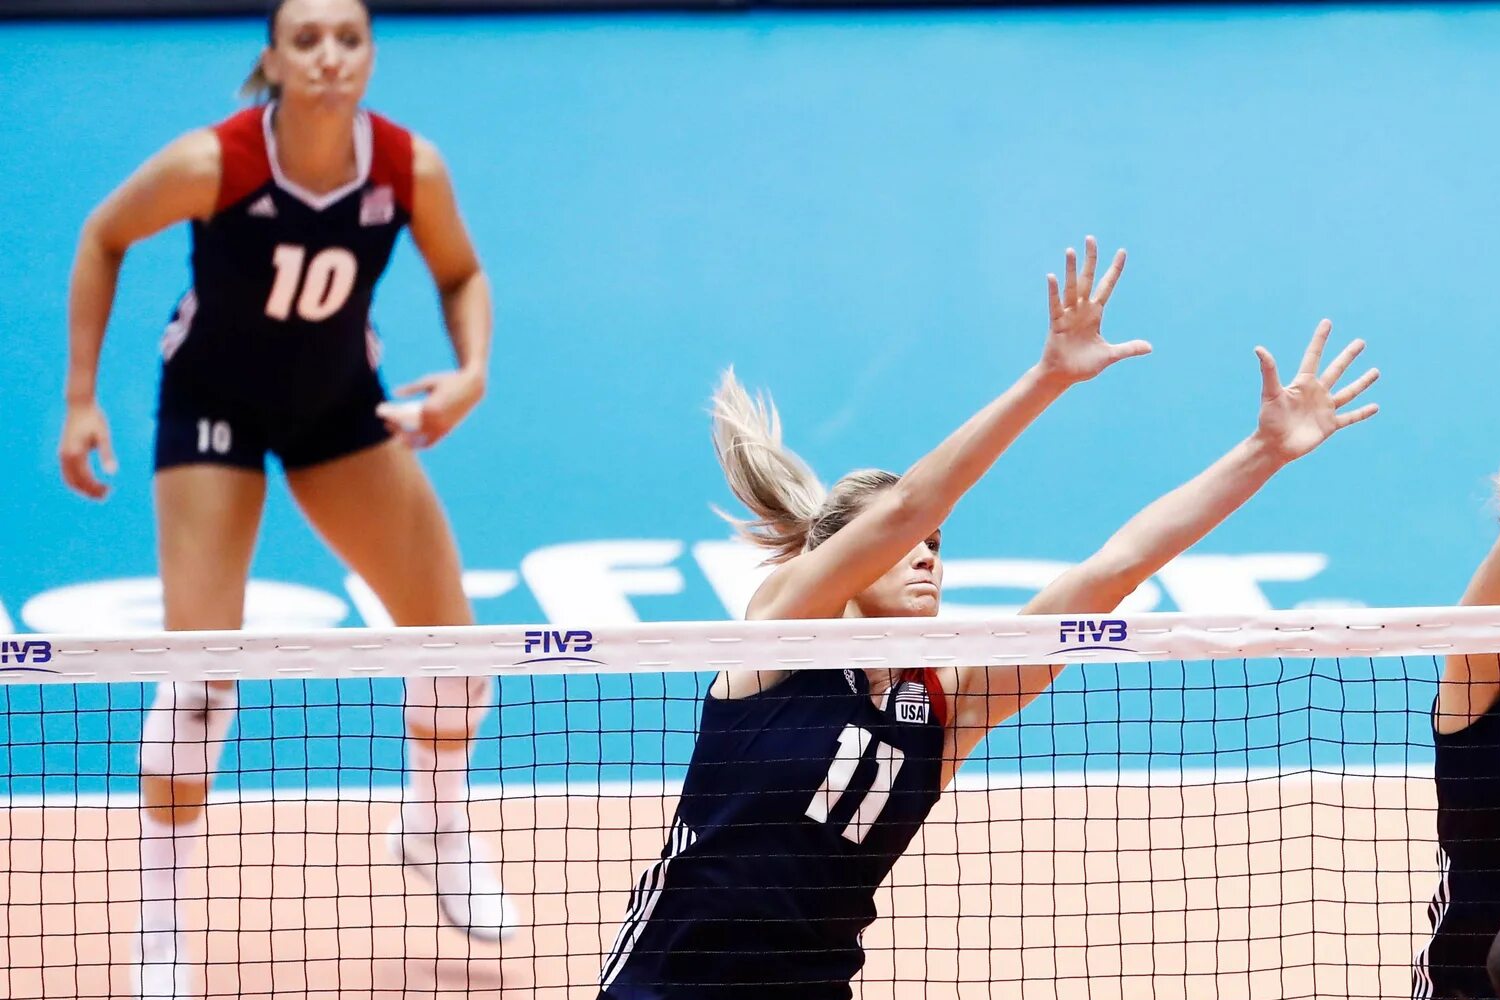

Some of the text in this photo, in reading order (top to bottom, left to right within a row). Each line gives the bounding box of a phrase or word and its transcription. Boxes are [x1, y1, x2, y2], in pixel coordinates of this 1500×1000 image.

[264, 243, 358, 322] 10
[197, 418, 232, 454] 10
[525, 631, 592, 653] FIVB
[1060, 620, 1127, 643] FIVB
[900, 704, 925, 721] USA
[805, 724, 904, 845] 11
